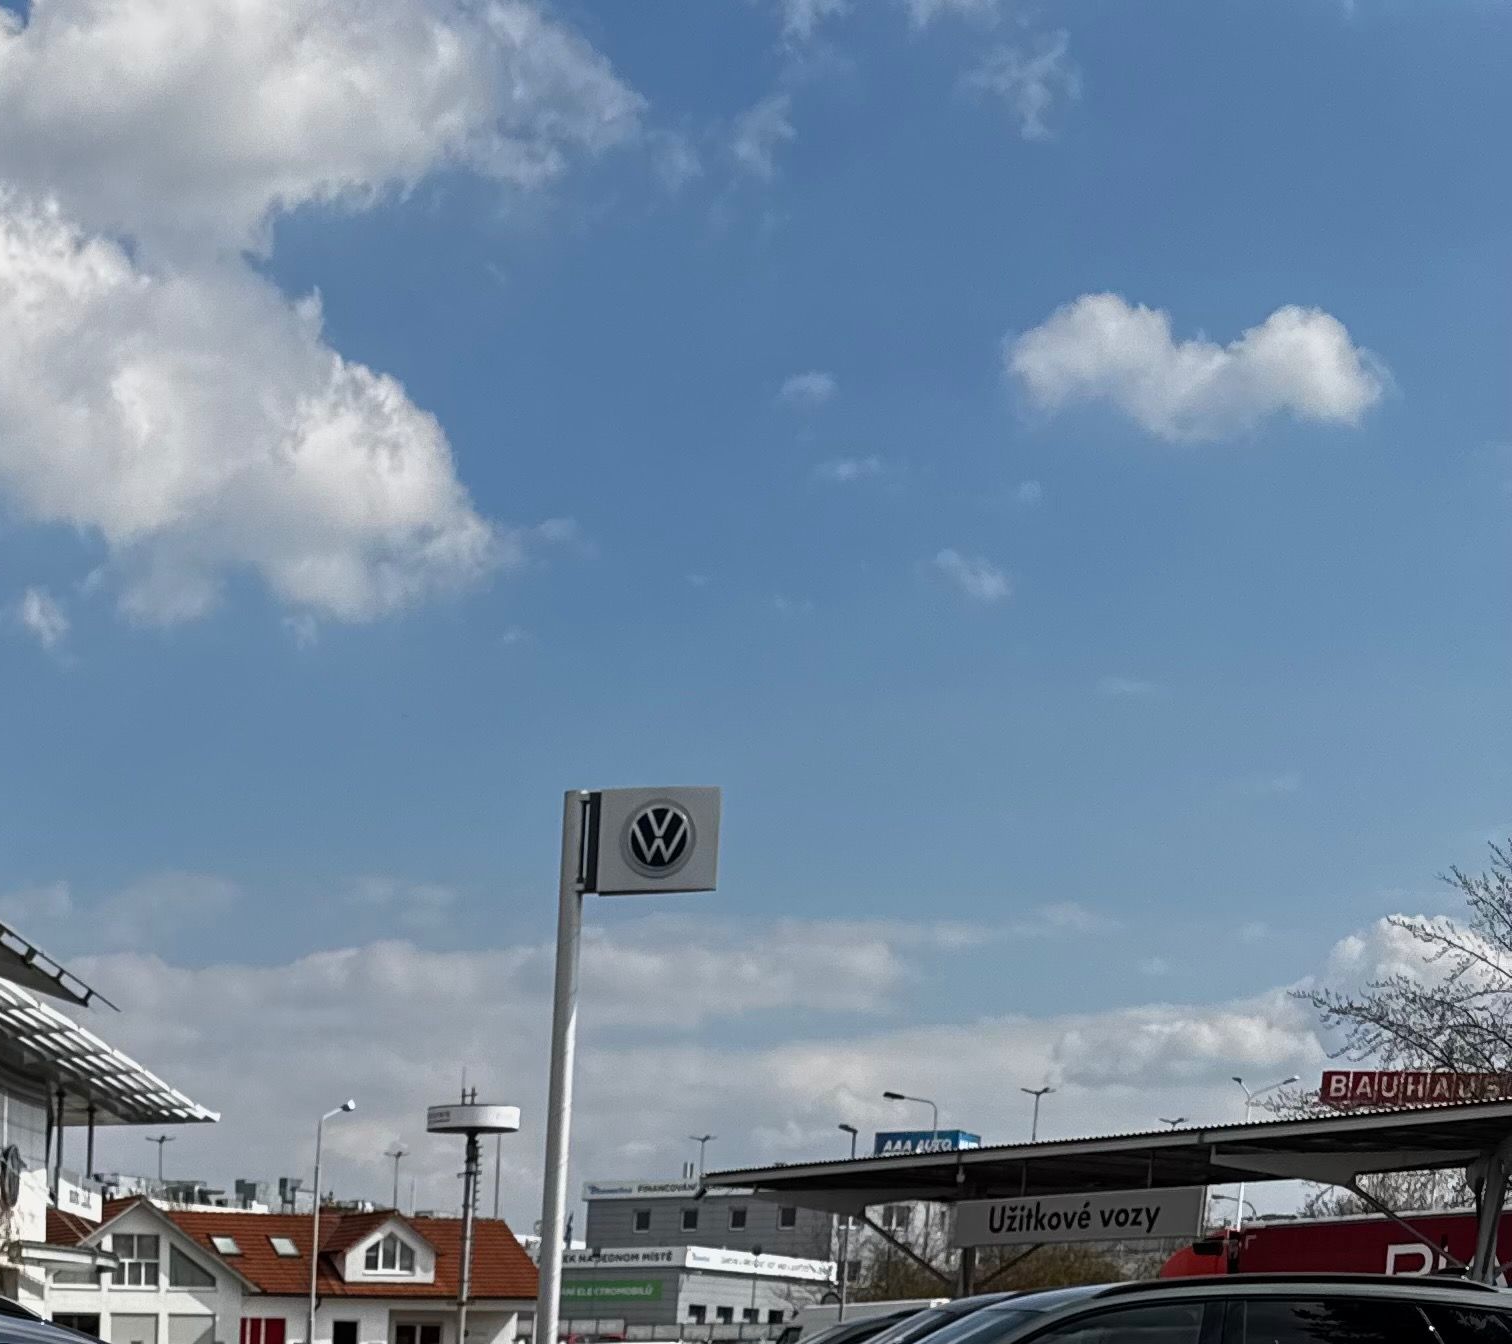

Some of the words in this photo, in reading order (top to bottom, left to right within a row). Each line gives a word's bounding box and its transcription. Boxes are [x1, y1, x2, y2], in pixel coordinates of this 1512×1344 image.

[883, 1140, 912, 1154] AAA
[915, 1138, 953, 1154] AUTO
[989, 1200, 1092, 1234] Užitkové
[1100, 1206, 1161, 1234] vozy
